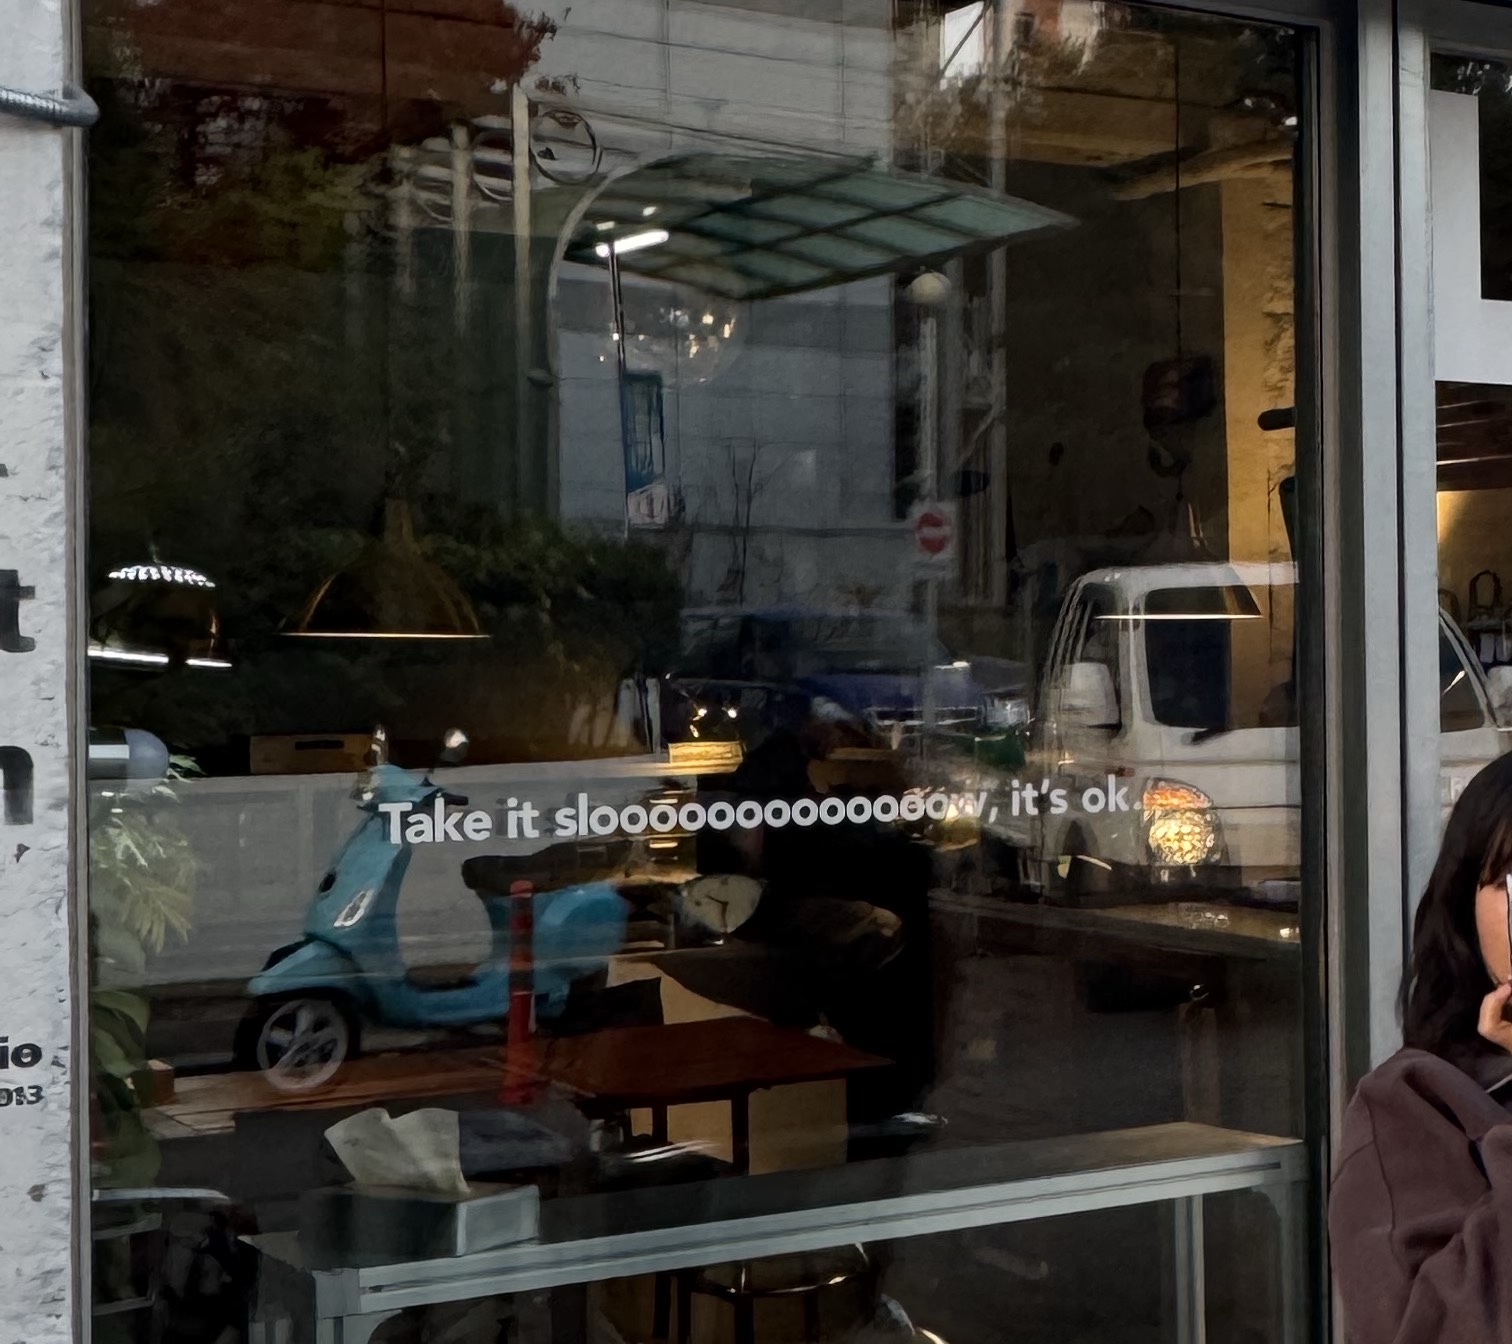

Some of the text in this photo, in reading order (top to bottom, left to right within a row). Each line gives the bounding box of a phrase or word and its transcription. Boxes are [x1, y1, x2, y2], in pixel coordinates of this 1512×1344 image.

[378, 795, 492, 844] Take
[506, 797, 540, 839] it
[1011, 777, 1067, 817] it's
